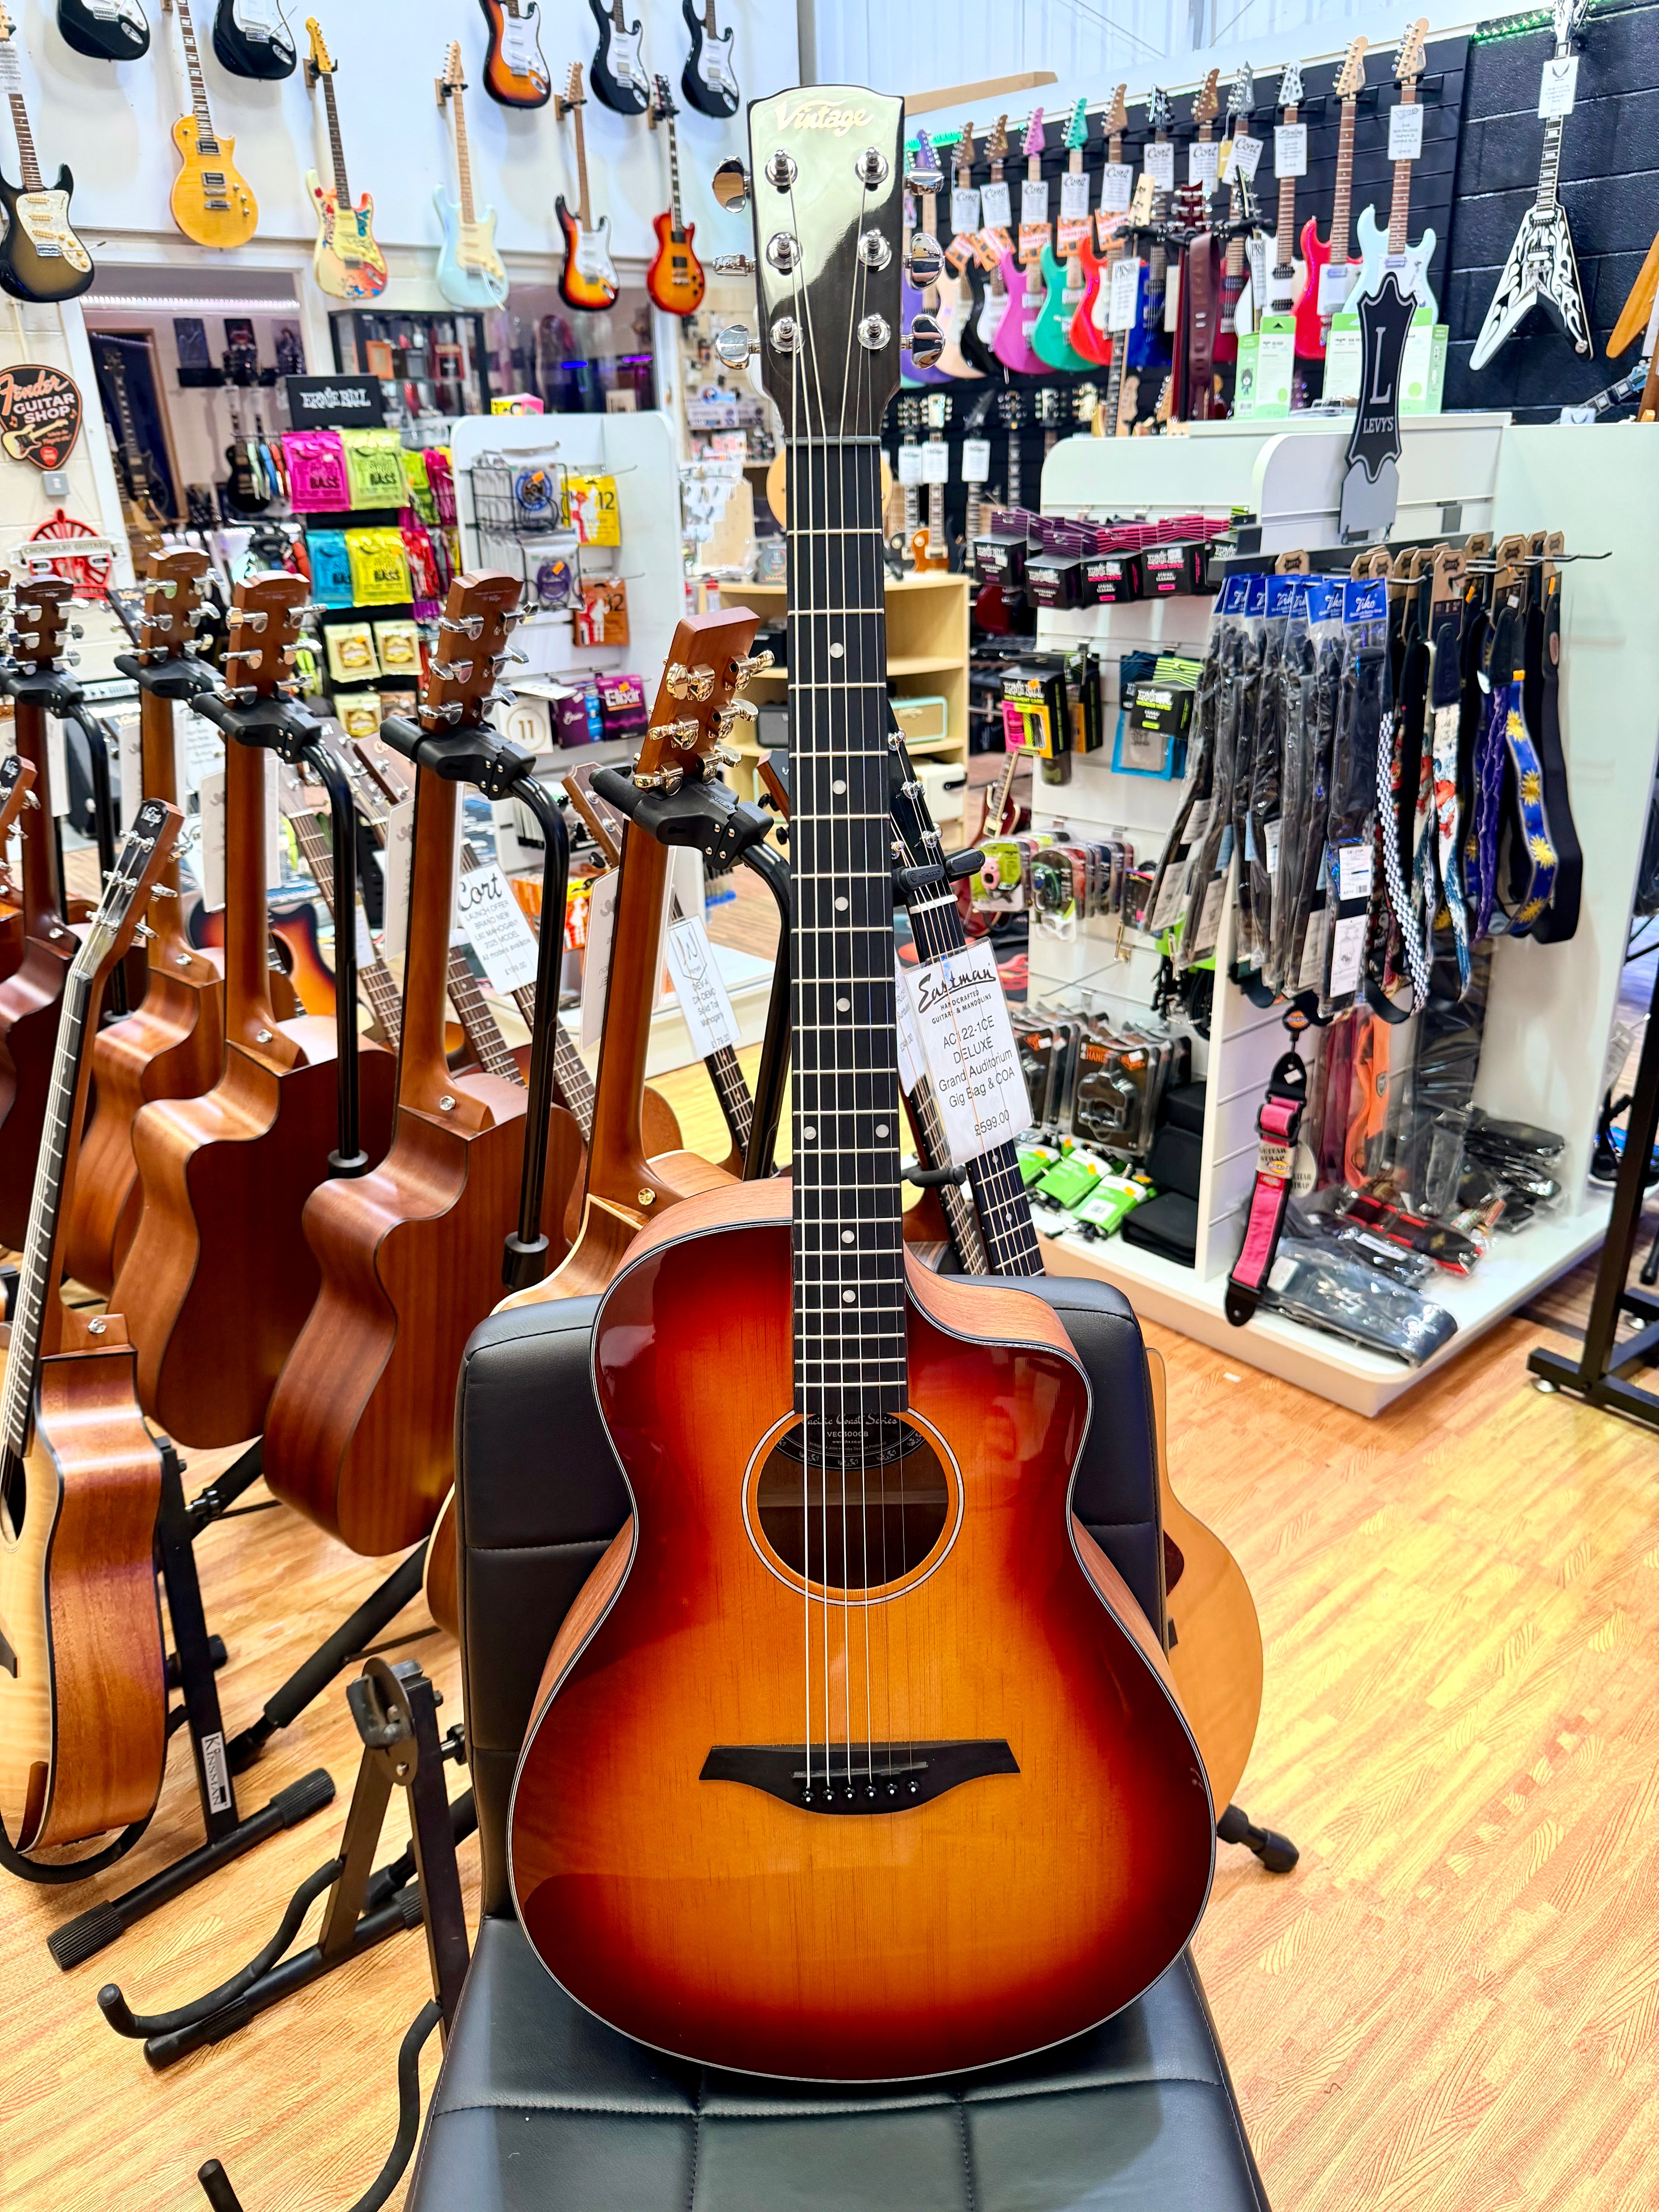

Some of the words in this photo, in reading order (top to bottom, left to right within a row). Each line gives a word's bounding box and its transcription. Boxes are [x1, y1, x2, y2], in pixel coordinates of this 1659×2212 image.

[775, 100, 874, 137] Vintage
[1370, 327, 1391, 404] L
[0, 370, 69, 416] Fender
[13, 393, 76, 414] GUITAR
[24, 405, 70, 424] SHOP
[1363, 416, 1394, 434] LEVY'S
[599, 492, 615, 510] 12
[609, 593, 624, 611] 12
[519, 720, 534, 740] 11
[458, 873, 502, 912] Cort
[918, 969, 996, 1013] Eastman
[940, 989, 979, 1011] HANDCRAFTED
[932, 1010, 955, 1024] GUITARS
[962, 993, 992, 1011] MANDOLINS
[711, 1033, 730, 1049] £79.00
[953, 1036, 994, 1064] DELUXE
[939, 1071, 967, 1092] Grand
[969, 1049, 1013, 1078] Auditorium
[949, 1092, 965, 1108] Gig
[966, 1084, 987, 1099] Bag
[988, 1077, 995, 1089] &
[995, 1067, 1015, 1085] COA
[974, 1109, 1010, 1137] £599.00
[804, 1417, 833, 1425] aciic
[836, 1413, 865, 1425] Coast
[866, 1413, 898, 1425] Series
